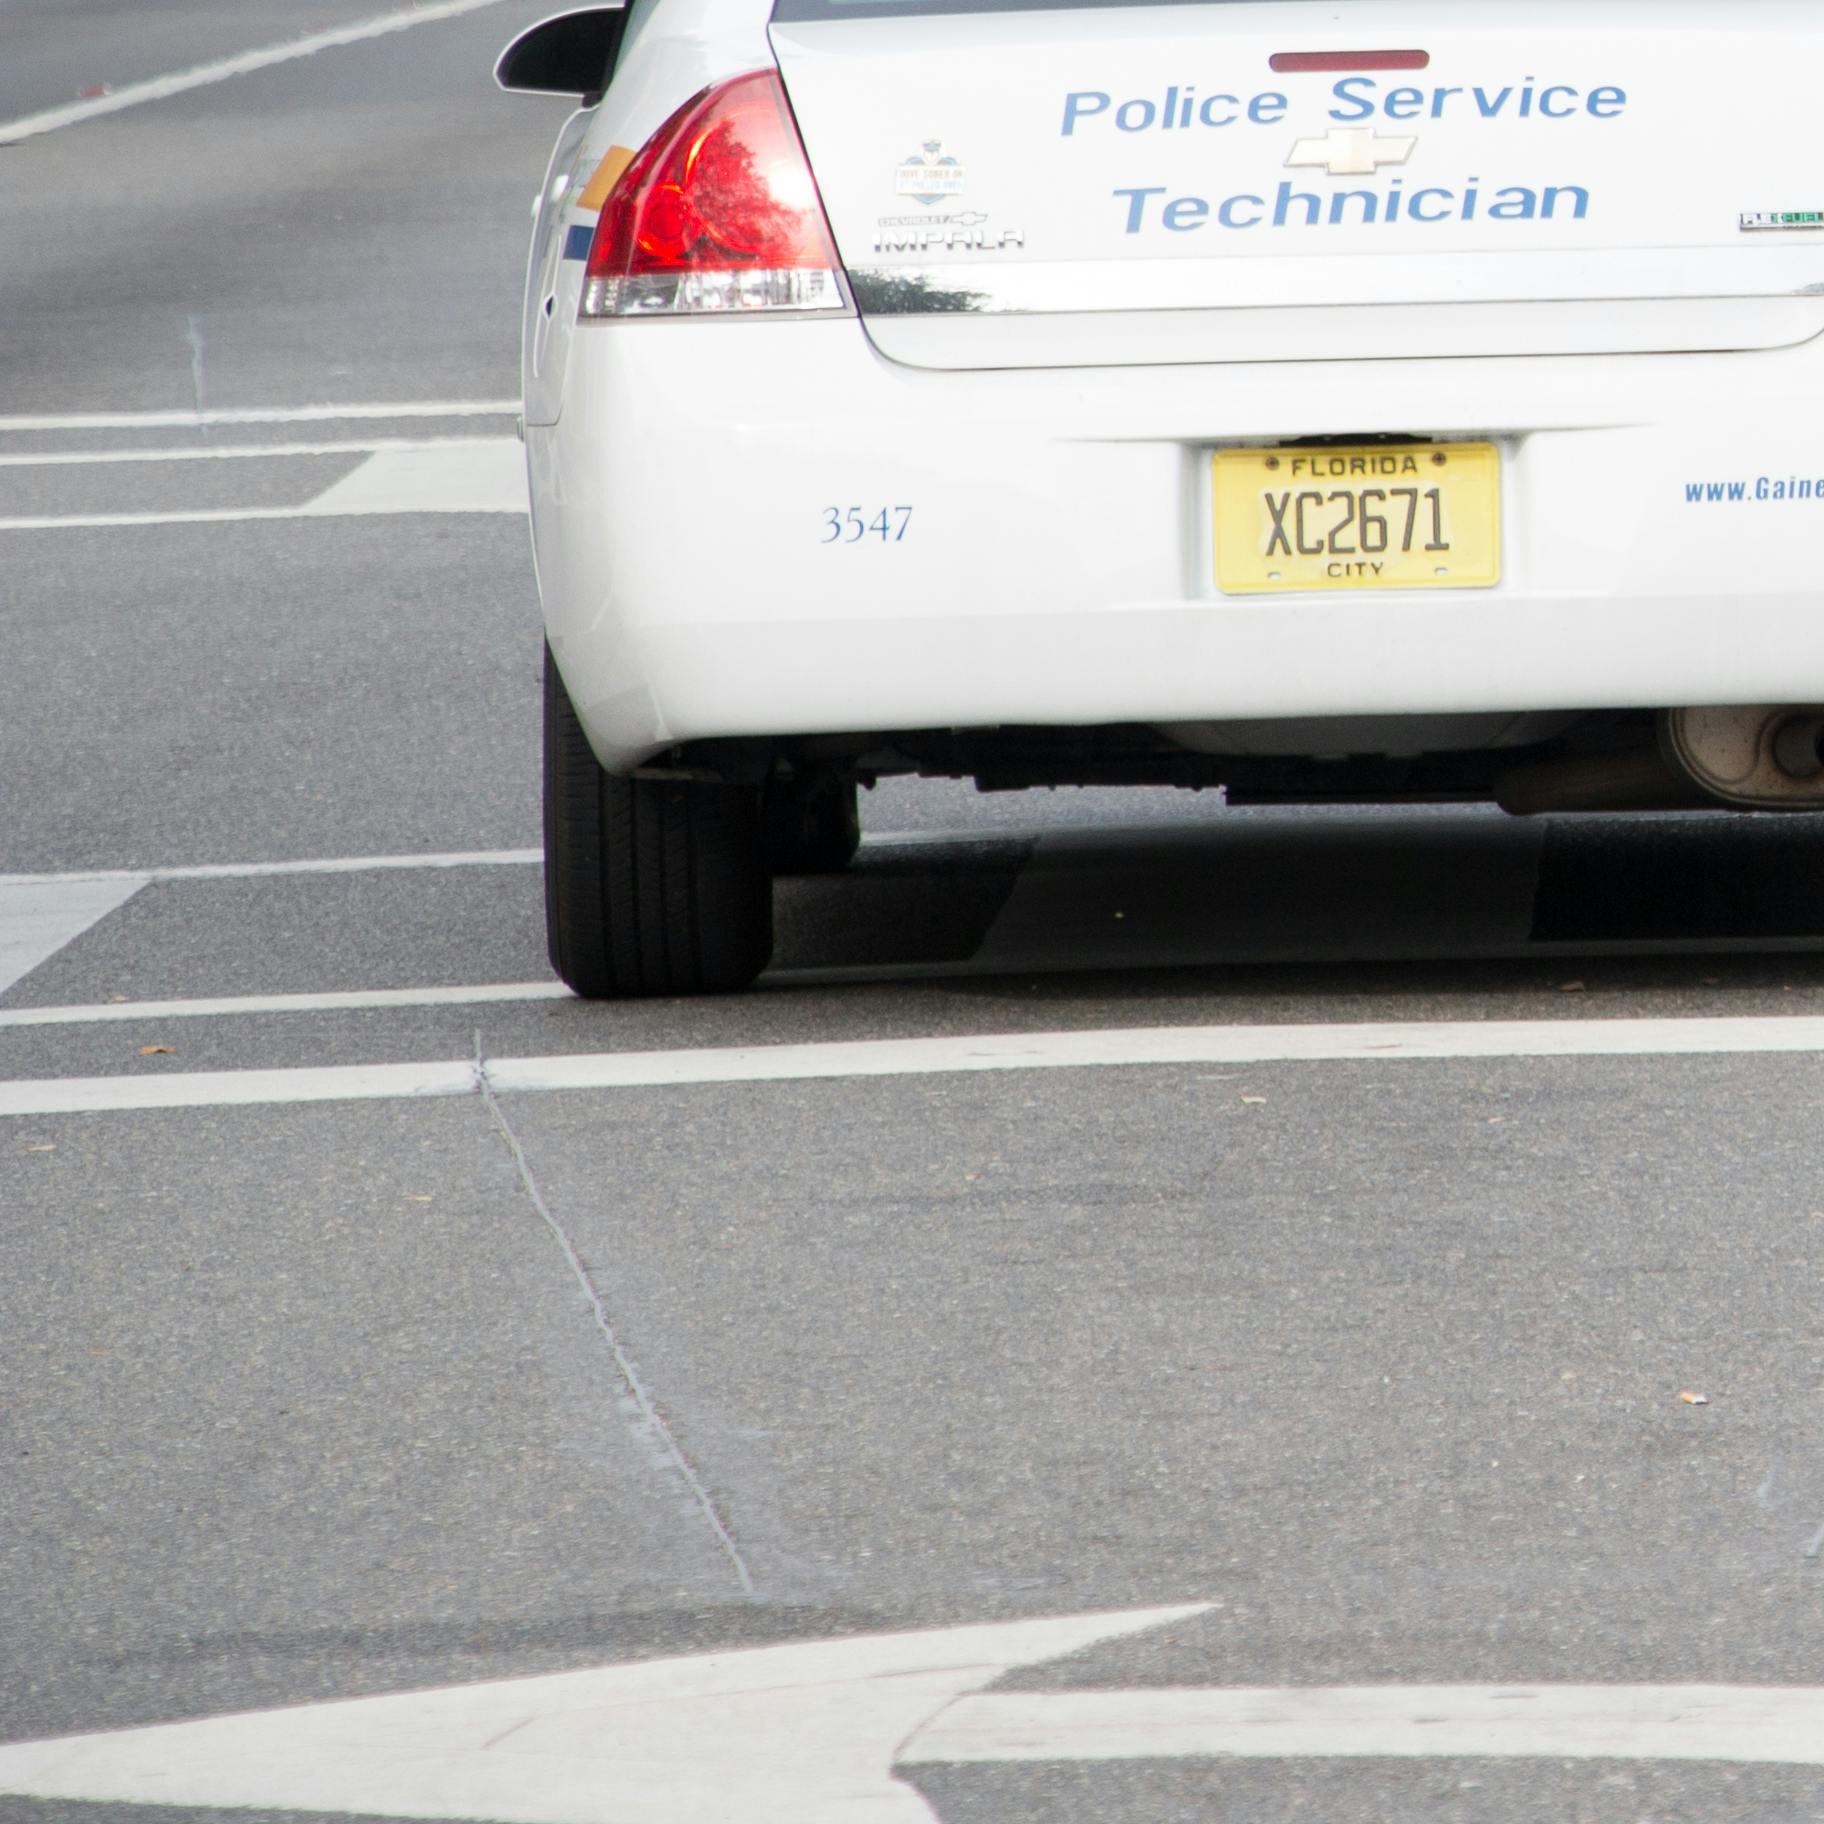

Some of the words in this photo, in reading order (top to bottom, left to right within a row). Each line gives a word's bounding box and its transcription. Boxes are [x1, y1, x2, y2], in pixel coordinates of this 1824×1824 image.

[1060, 85, 1289, 136] Police
[1327, 76, 1627, 122] Service
[1112, 176, 1590, 234] Technician
[873, 230, 1025, 253] IMPALA
[1291, 455, 1419, 477] FLORIDA
[820, 505, 913, 544] 3547
[1264, 487, 1451, 558] XC2671
[1326, 561, 1385, 579] CITY
